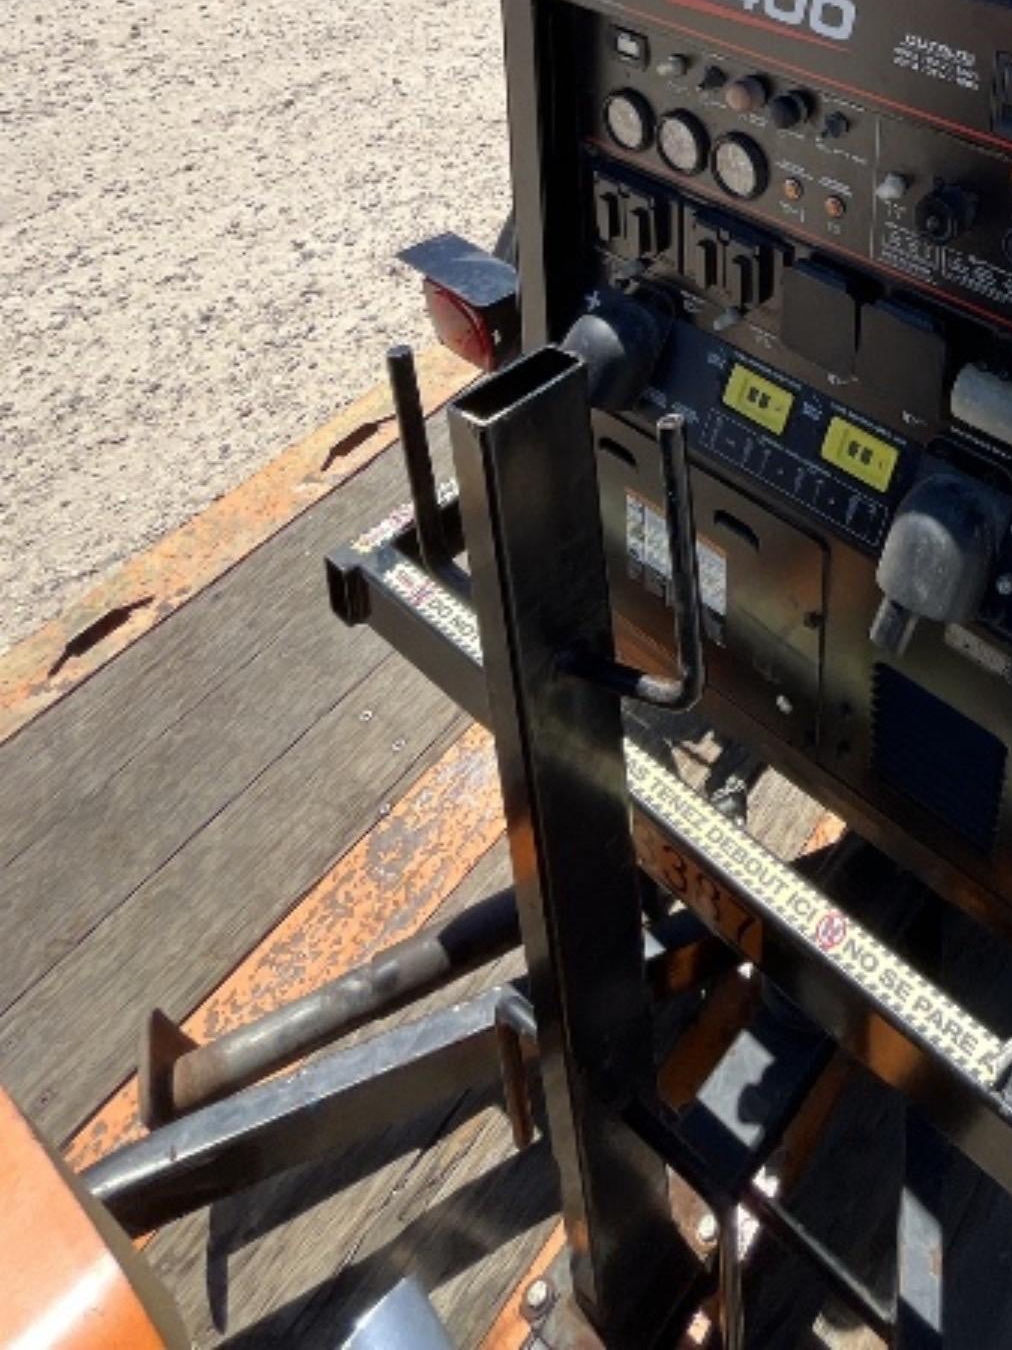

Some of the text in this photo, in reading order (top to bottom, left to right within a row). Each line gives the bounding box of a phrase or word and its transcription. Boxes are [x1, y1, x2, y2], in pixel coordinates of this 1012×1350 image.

[706, 826, 790, 895] DEBOUT
[843, 938, 879, 973] NO
[878, 969, 914, 1003] SE
[912, 996, 979, 1057] PARE
